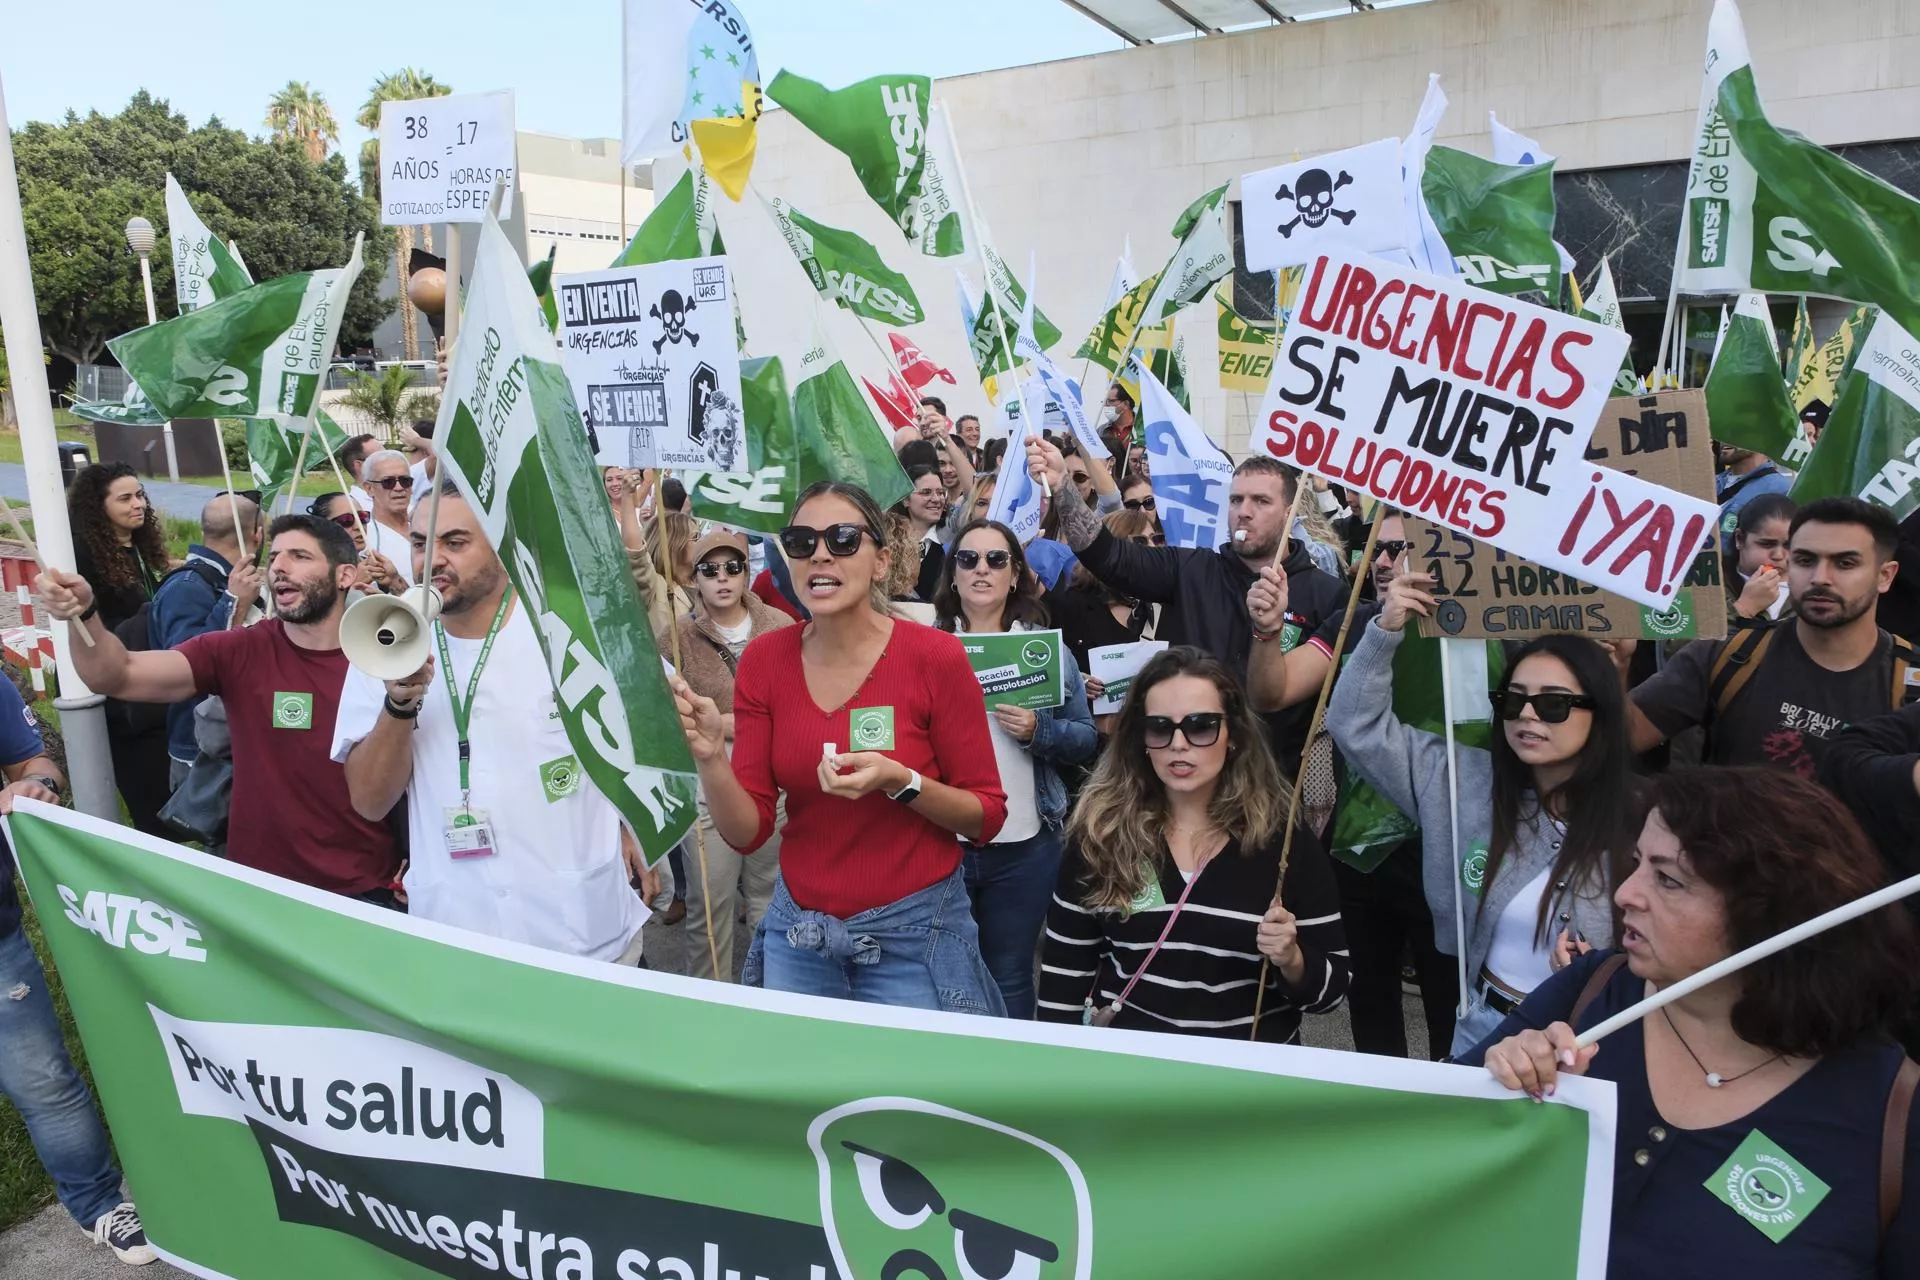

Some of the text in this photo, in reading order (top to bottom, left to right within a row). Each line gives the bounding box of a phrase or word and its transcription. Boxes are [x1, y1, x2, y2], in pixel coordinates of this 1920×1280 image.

[405, 115, 428, 139] 38
[456, 120, 478, 145] 17
[391, 156, 439, 180] AÑOS
[450, 167, 492, 186] HORAS
[1704, 164, 1729, 195] de
[388, 202, 444, 216] COTIZADOS
[1702, 200, 1722, 264] SATSE
[702, 266, 723, 282] VENDE
[563, 287, 584, 323] EN
[588, 282, 641, 321] VENTA
[568, 328, 639, 354] URGENCIAS
[1299, 254, 1595, 410] URGENCIAS
[622, 371, 665, 382] URGENCIAS
[592, 390, 664, 427] SE VENDE
[1279, 334, 1361, 421] SE
[1373, 366, 1574, 497] MUERE
[661, 453, 705, 464] URGENCIAS
[1193, 458, 1234, 474] SINDICATO
[1266, 409, 1708, 597] SOLUCIONES ¡YA!
[1423, 527, 1475, 561] 25
[1426, 558, 1479, 597] 12
[1482, 603, 1613, 632] CAMAS
[1101, 651, 1125, 661] SATSE
[992, 673, 1046, 693] explotación
[56, 883, 207, 963] SATSE
[172, 1032, 505, 1149] Por tu salud
[1755, 1153, 1806, 1195] URGENCIAS
[1727, 1163, 1797, 1224] SOLUCIONES ¡YA!
[270, 1142, 356, 1218] Por
[361, 1192, 596, 1280] nuestra
